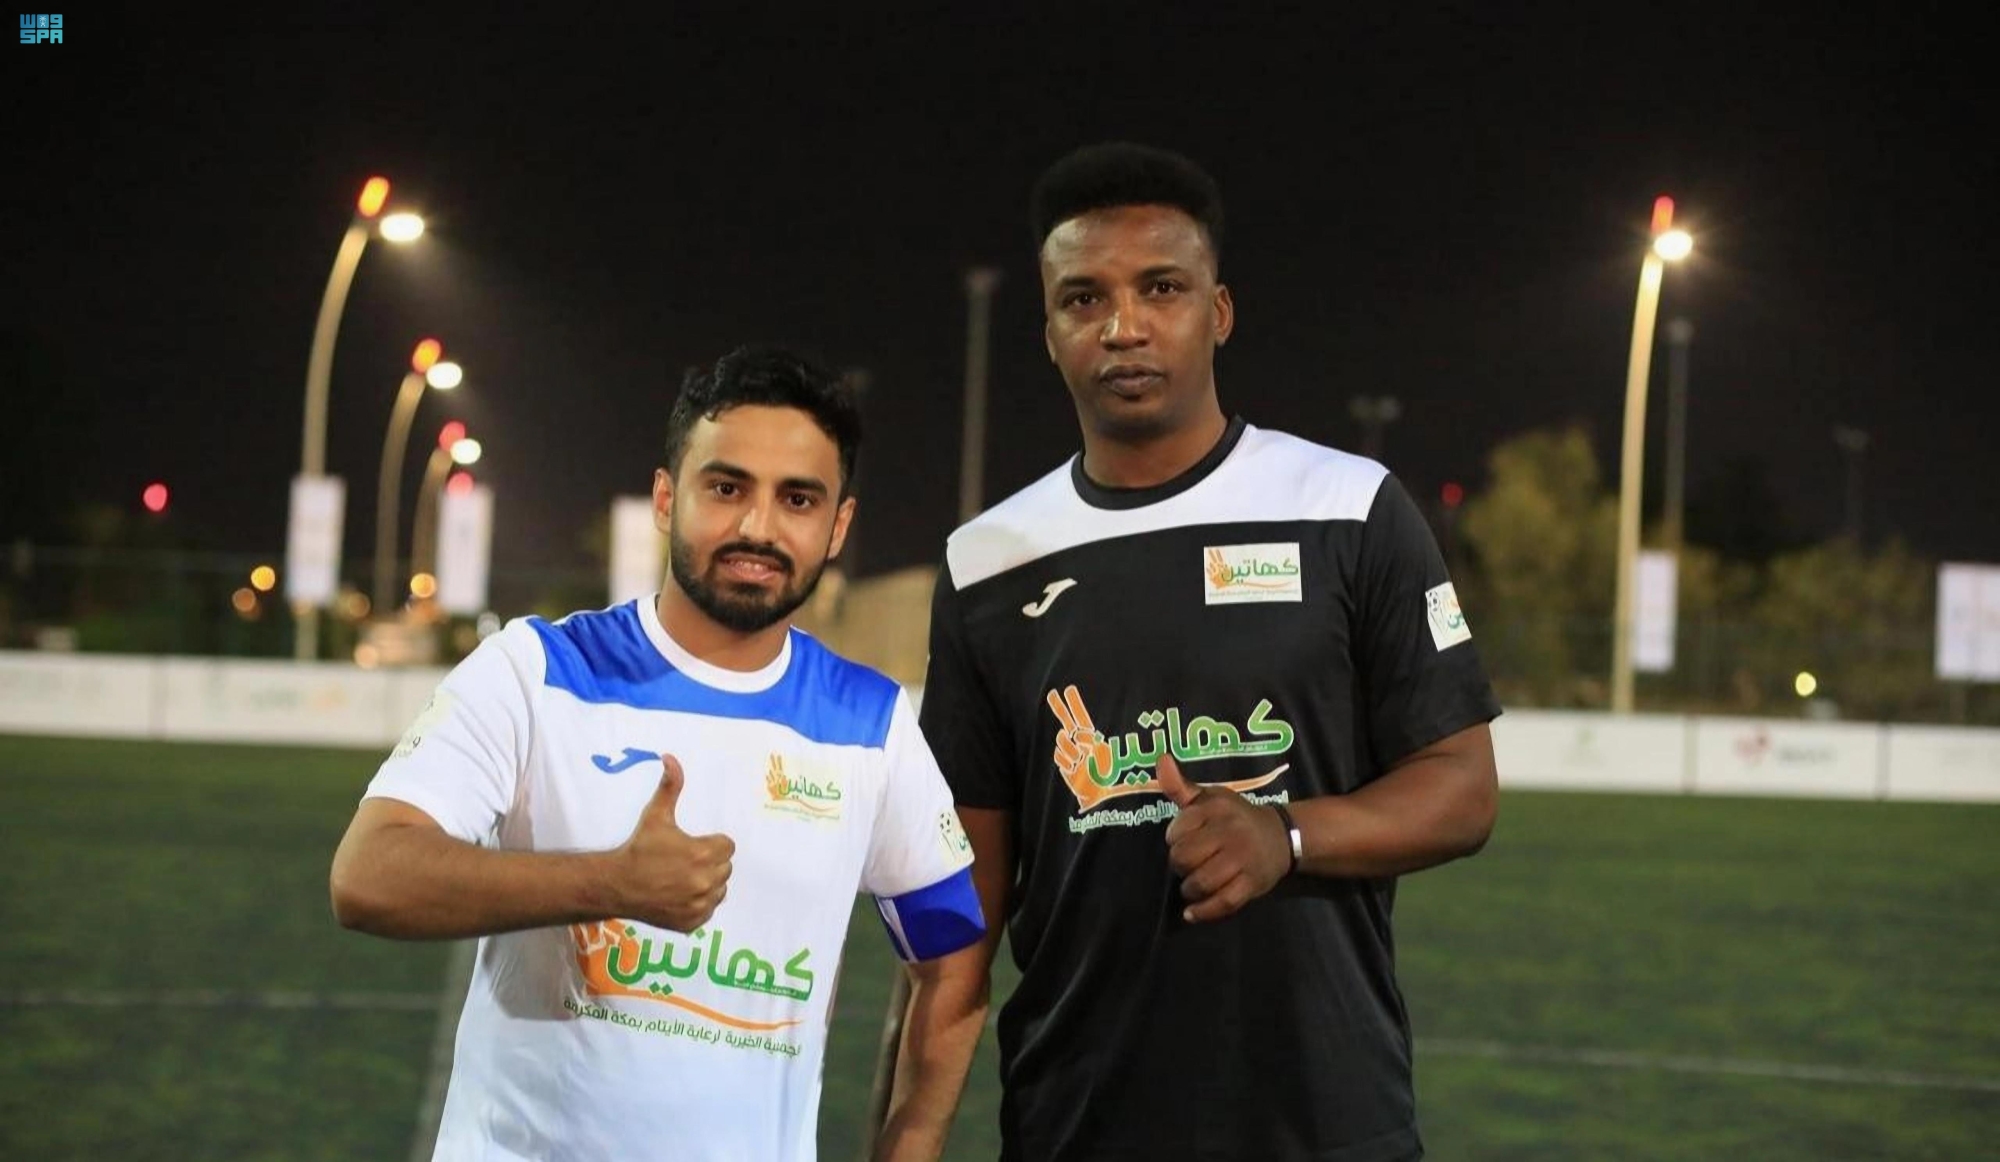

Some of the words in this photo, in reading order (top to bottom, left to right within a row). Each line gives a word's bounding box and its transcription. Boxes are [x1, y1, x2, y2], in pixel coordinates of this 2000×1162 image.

[1221, 558, 1299, 585] كهاتين
[1088, 698, 1294, 787] كهاتين
[611, 1011, 643, 1032] بمكة
[645, 1018, 685, 1036] الأيتام
[687, 1025, 721, 1045] لرعاية
[725, 1031, 763, 1049] الخيرية
